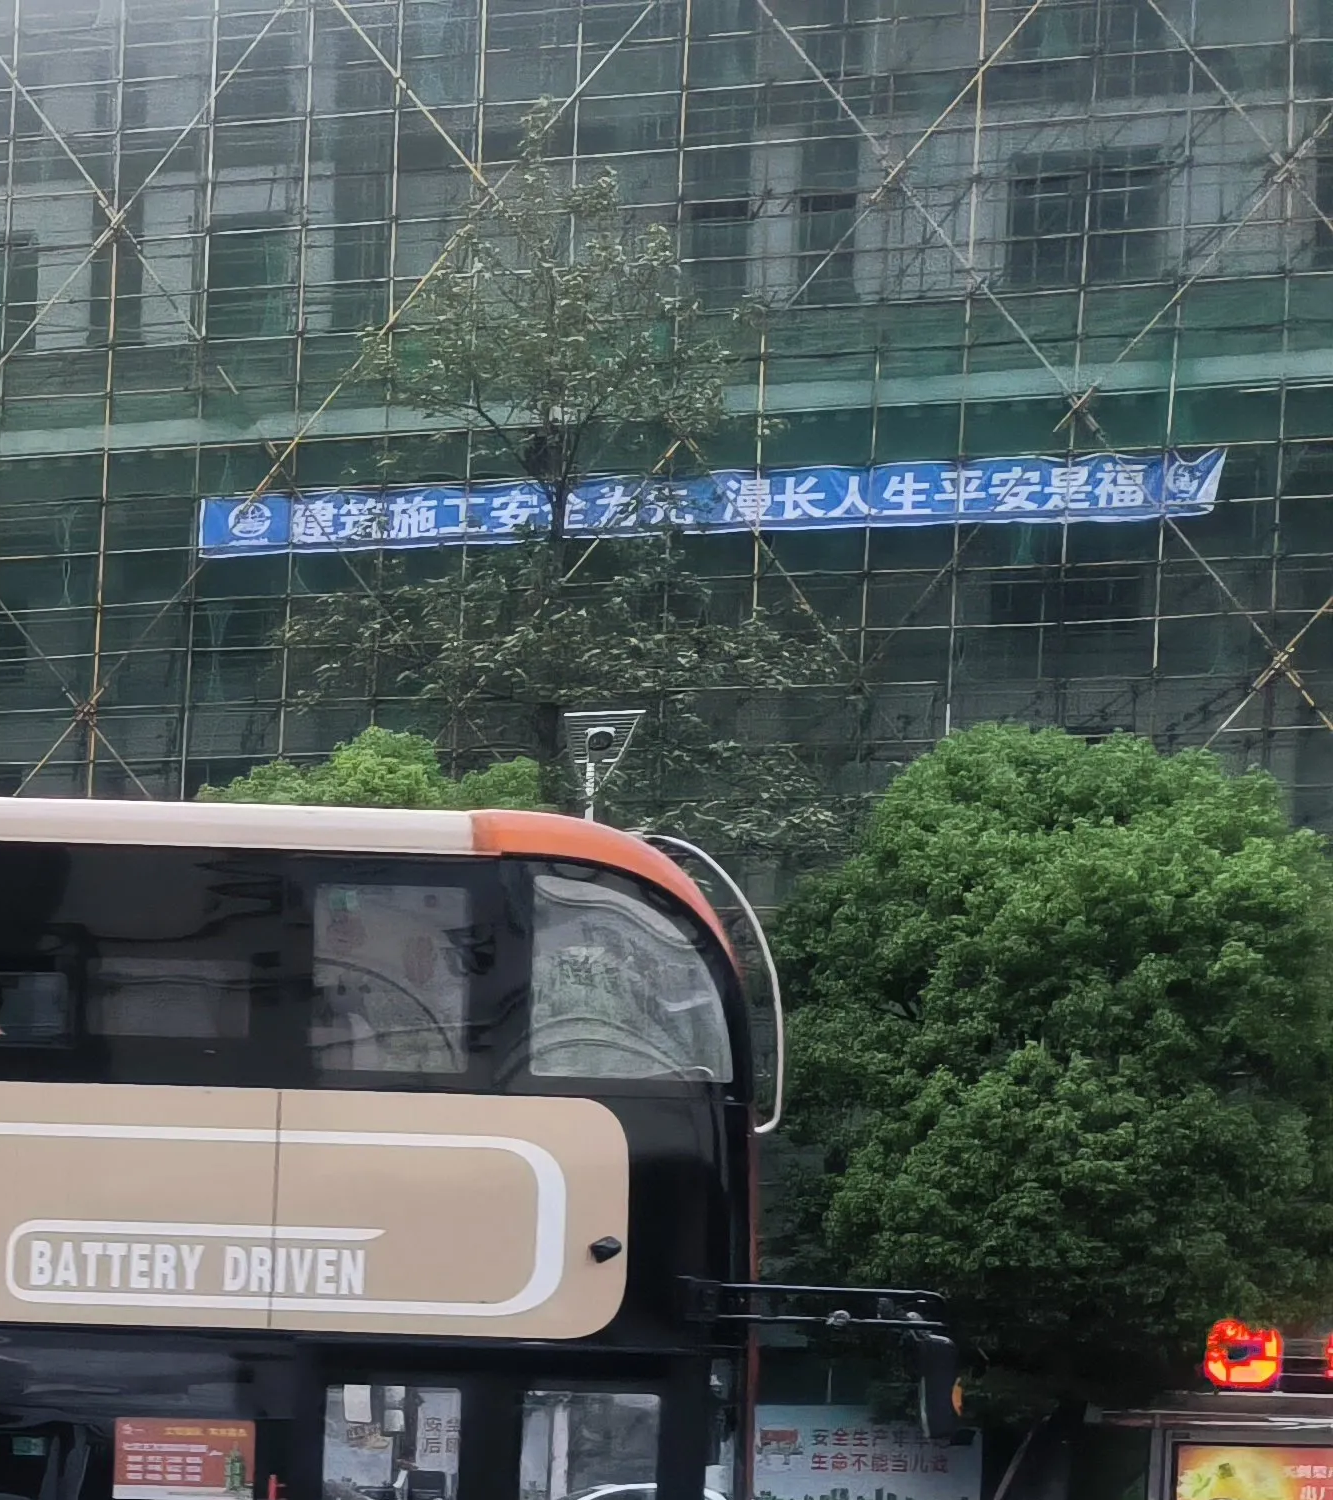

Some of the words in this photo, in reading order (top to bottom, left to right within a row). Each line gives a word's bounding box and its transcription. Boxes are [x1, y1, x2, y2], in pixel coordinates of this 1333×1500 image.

[723, 462, 1147, 522] 漫长人生平安是福
[29, 1240, 206, 1291] BATTERY
[222, 1245, 366, 1296] DRIVEN
